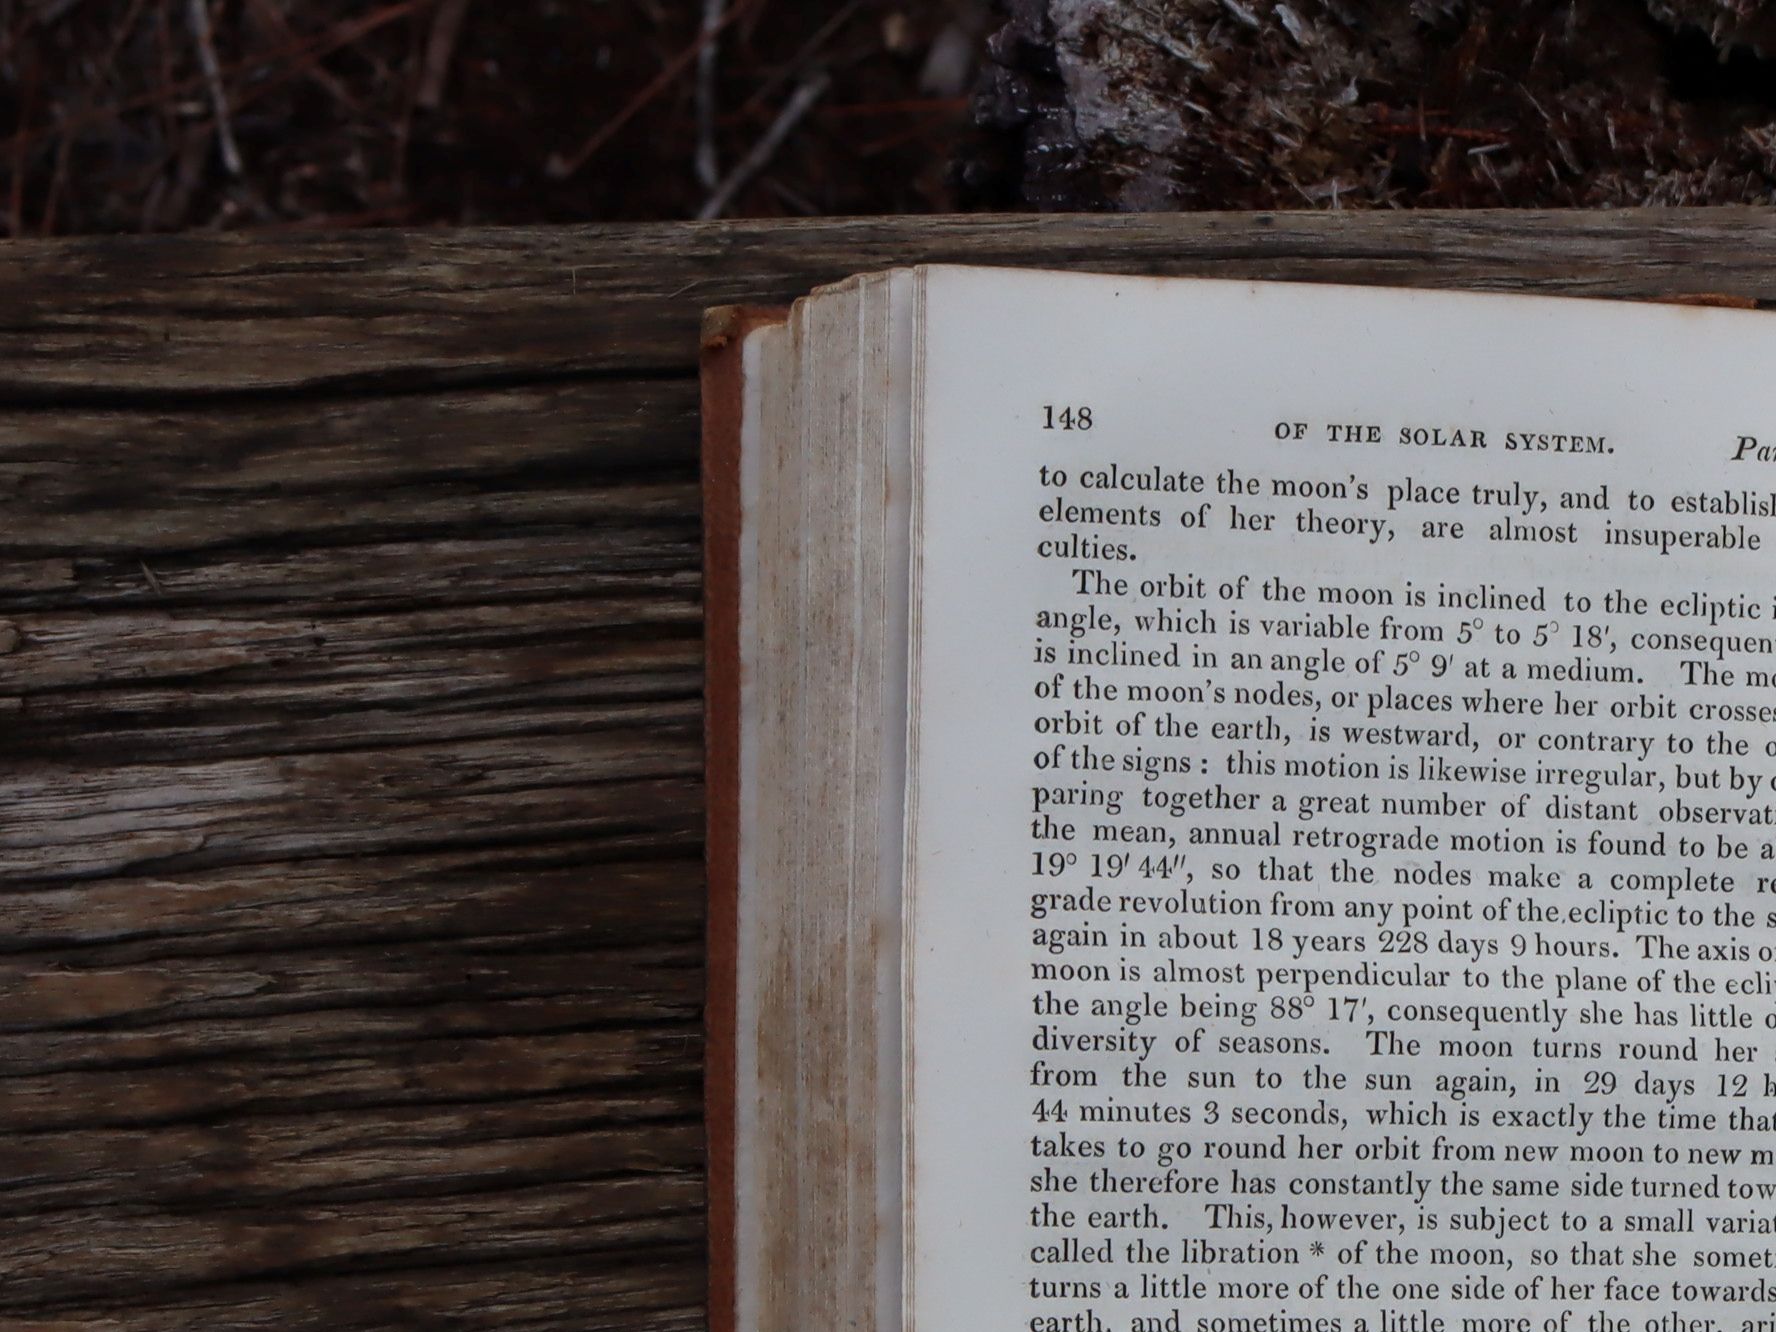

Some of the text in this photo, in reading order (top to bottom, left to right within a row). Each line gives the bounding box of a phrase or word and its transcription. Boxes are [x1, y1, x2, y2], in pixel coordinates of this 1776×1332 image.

[1042, 404, 1094, 432] 148
[1274, 421, 1615, 455] OF THE SOLAR SYSTEM.
[1038, 464, 1068, 488] to
[1079, 462, 1205, 494] calculate
[1216, 467, 1261, 496] the
[1386, 476, 1461, 511] place
[1471, 480, 1548, 517] truly,
[1559, 484, 1611, 511] and
[1627, 489, 1655, 512] to
[1031, 779, 1124, 816] paring
[1141, 783, 1261, 818] together
[1271, 794, 1288, 812] a
[1297, 792, 1371, 822] great
[1381, 791, 1487, 818] number
[1500, 792, 1532, 819] of
[1545, 793, 1639, 822] distant
[1032, 920, 1109, 956] again
[1119, 921, 1147, 948] in
[1158, 923, 1239, 950] about
[1251, 927, 1284, 952] 18
[1291, 934, 1366, 961] years
[1377, 929, 1429, 955] 228
[1437, 928, 1499, 964] days
[1510, 933, 1527, 958] 9
[1533, 931, 1620, 959] hours.
[1635, 934, 1691, 961] The
[1697, 936, 1751, 963] axis
[1031, 1024, 1158, 1063] diversity
[1174, 1026, 1206, 1054] of
[1218, 1036, 1330, 1055] seasons.
[1365, 1029, 1421, 1057] The
[1438, 1039, 1514, 1058] moon
[1532, 1036, 1602, 1060] turns
[1618, 1036, 1699, 1062] round
[1713, 1036, 1759, 1064] her
